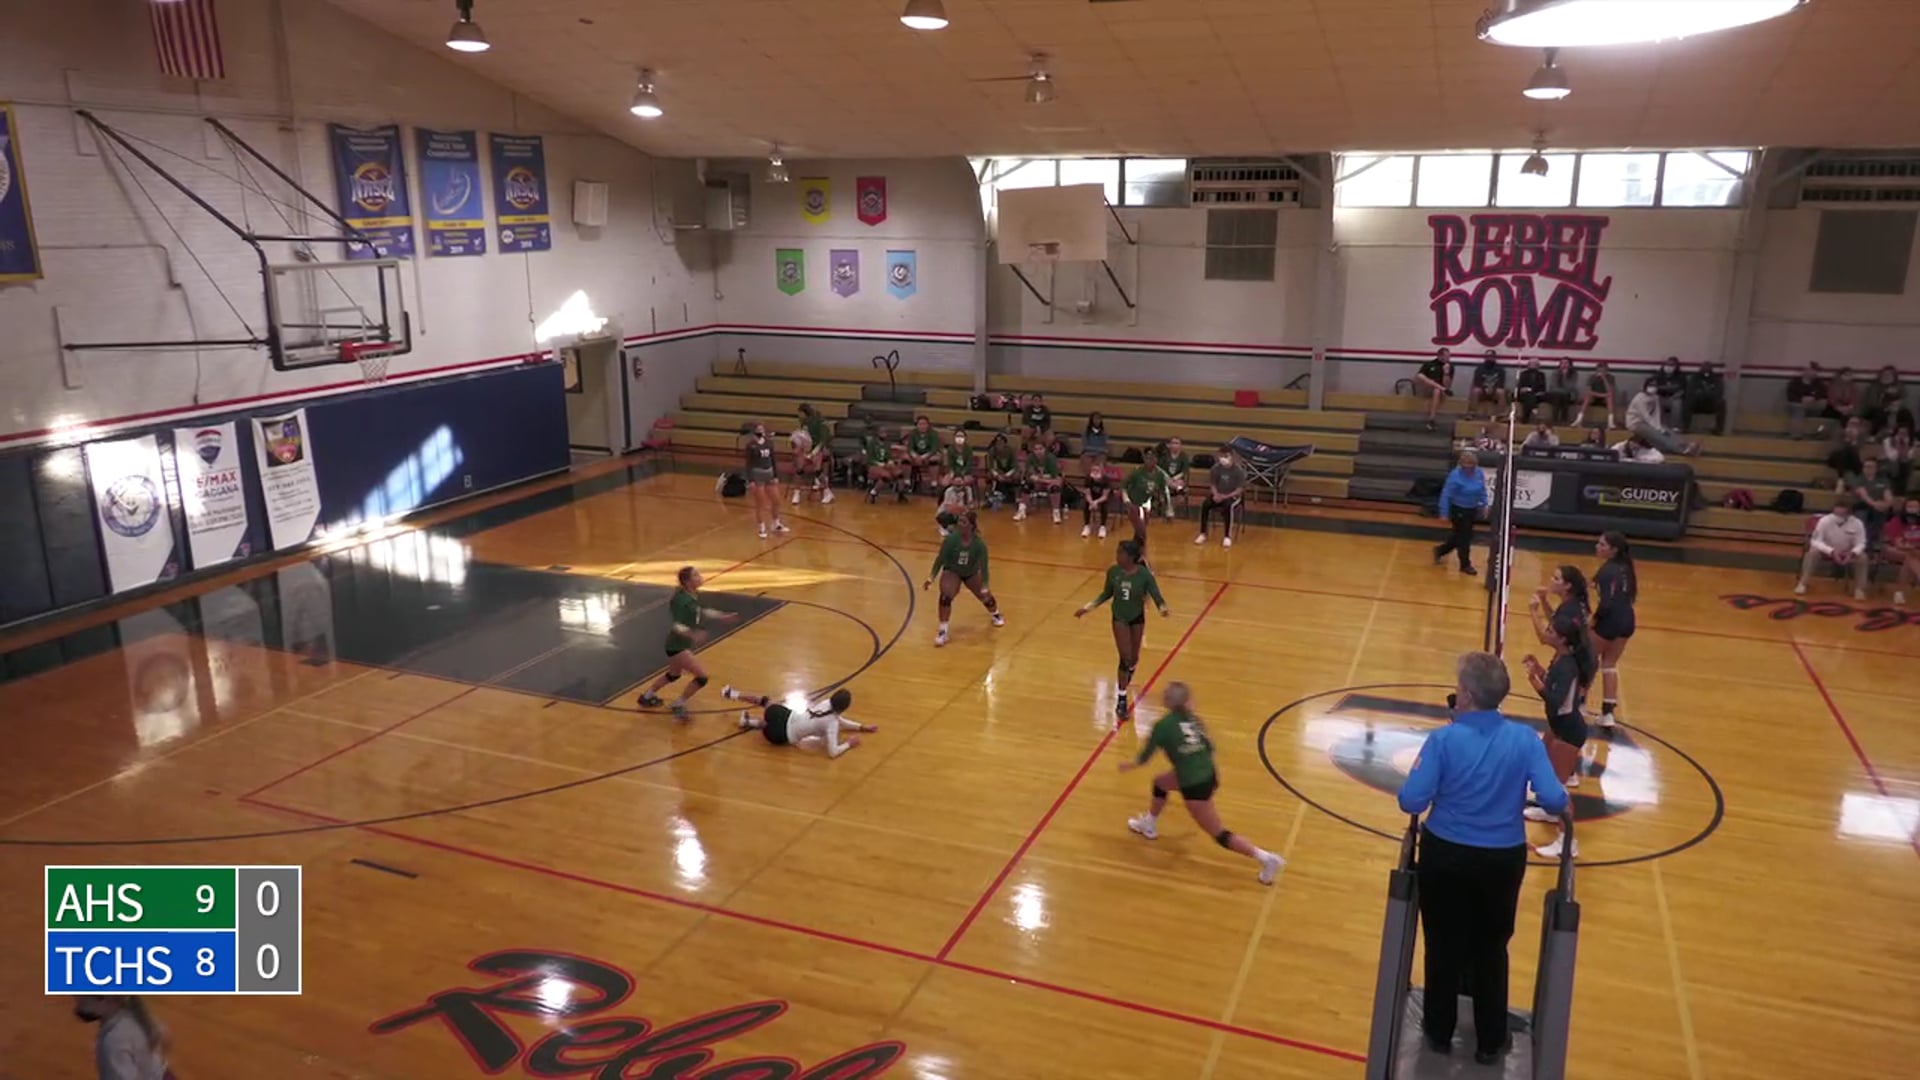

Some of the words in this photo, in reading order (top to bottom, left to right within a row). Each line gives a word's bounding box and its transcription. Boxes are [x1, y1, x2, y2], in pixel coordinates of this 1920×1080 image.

[1428, 214, 1612, 302] REBEL
[1430, 275, 1602, 350] DOME
[196, 470, 237, 488] E/MAX
[1621, 487, 1679, 502] GUIDRY
[1121, 588, 1130, 600] 3
